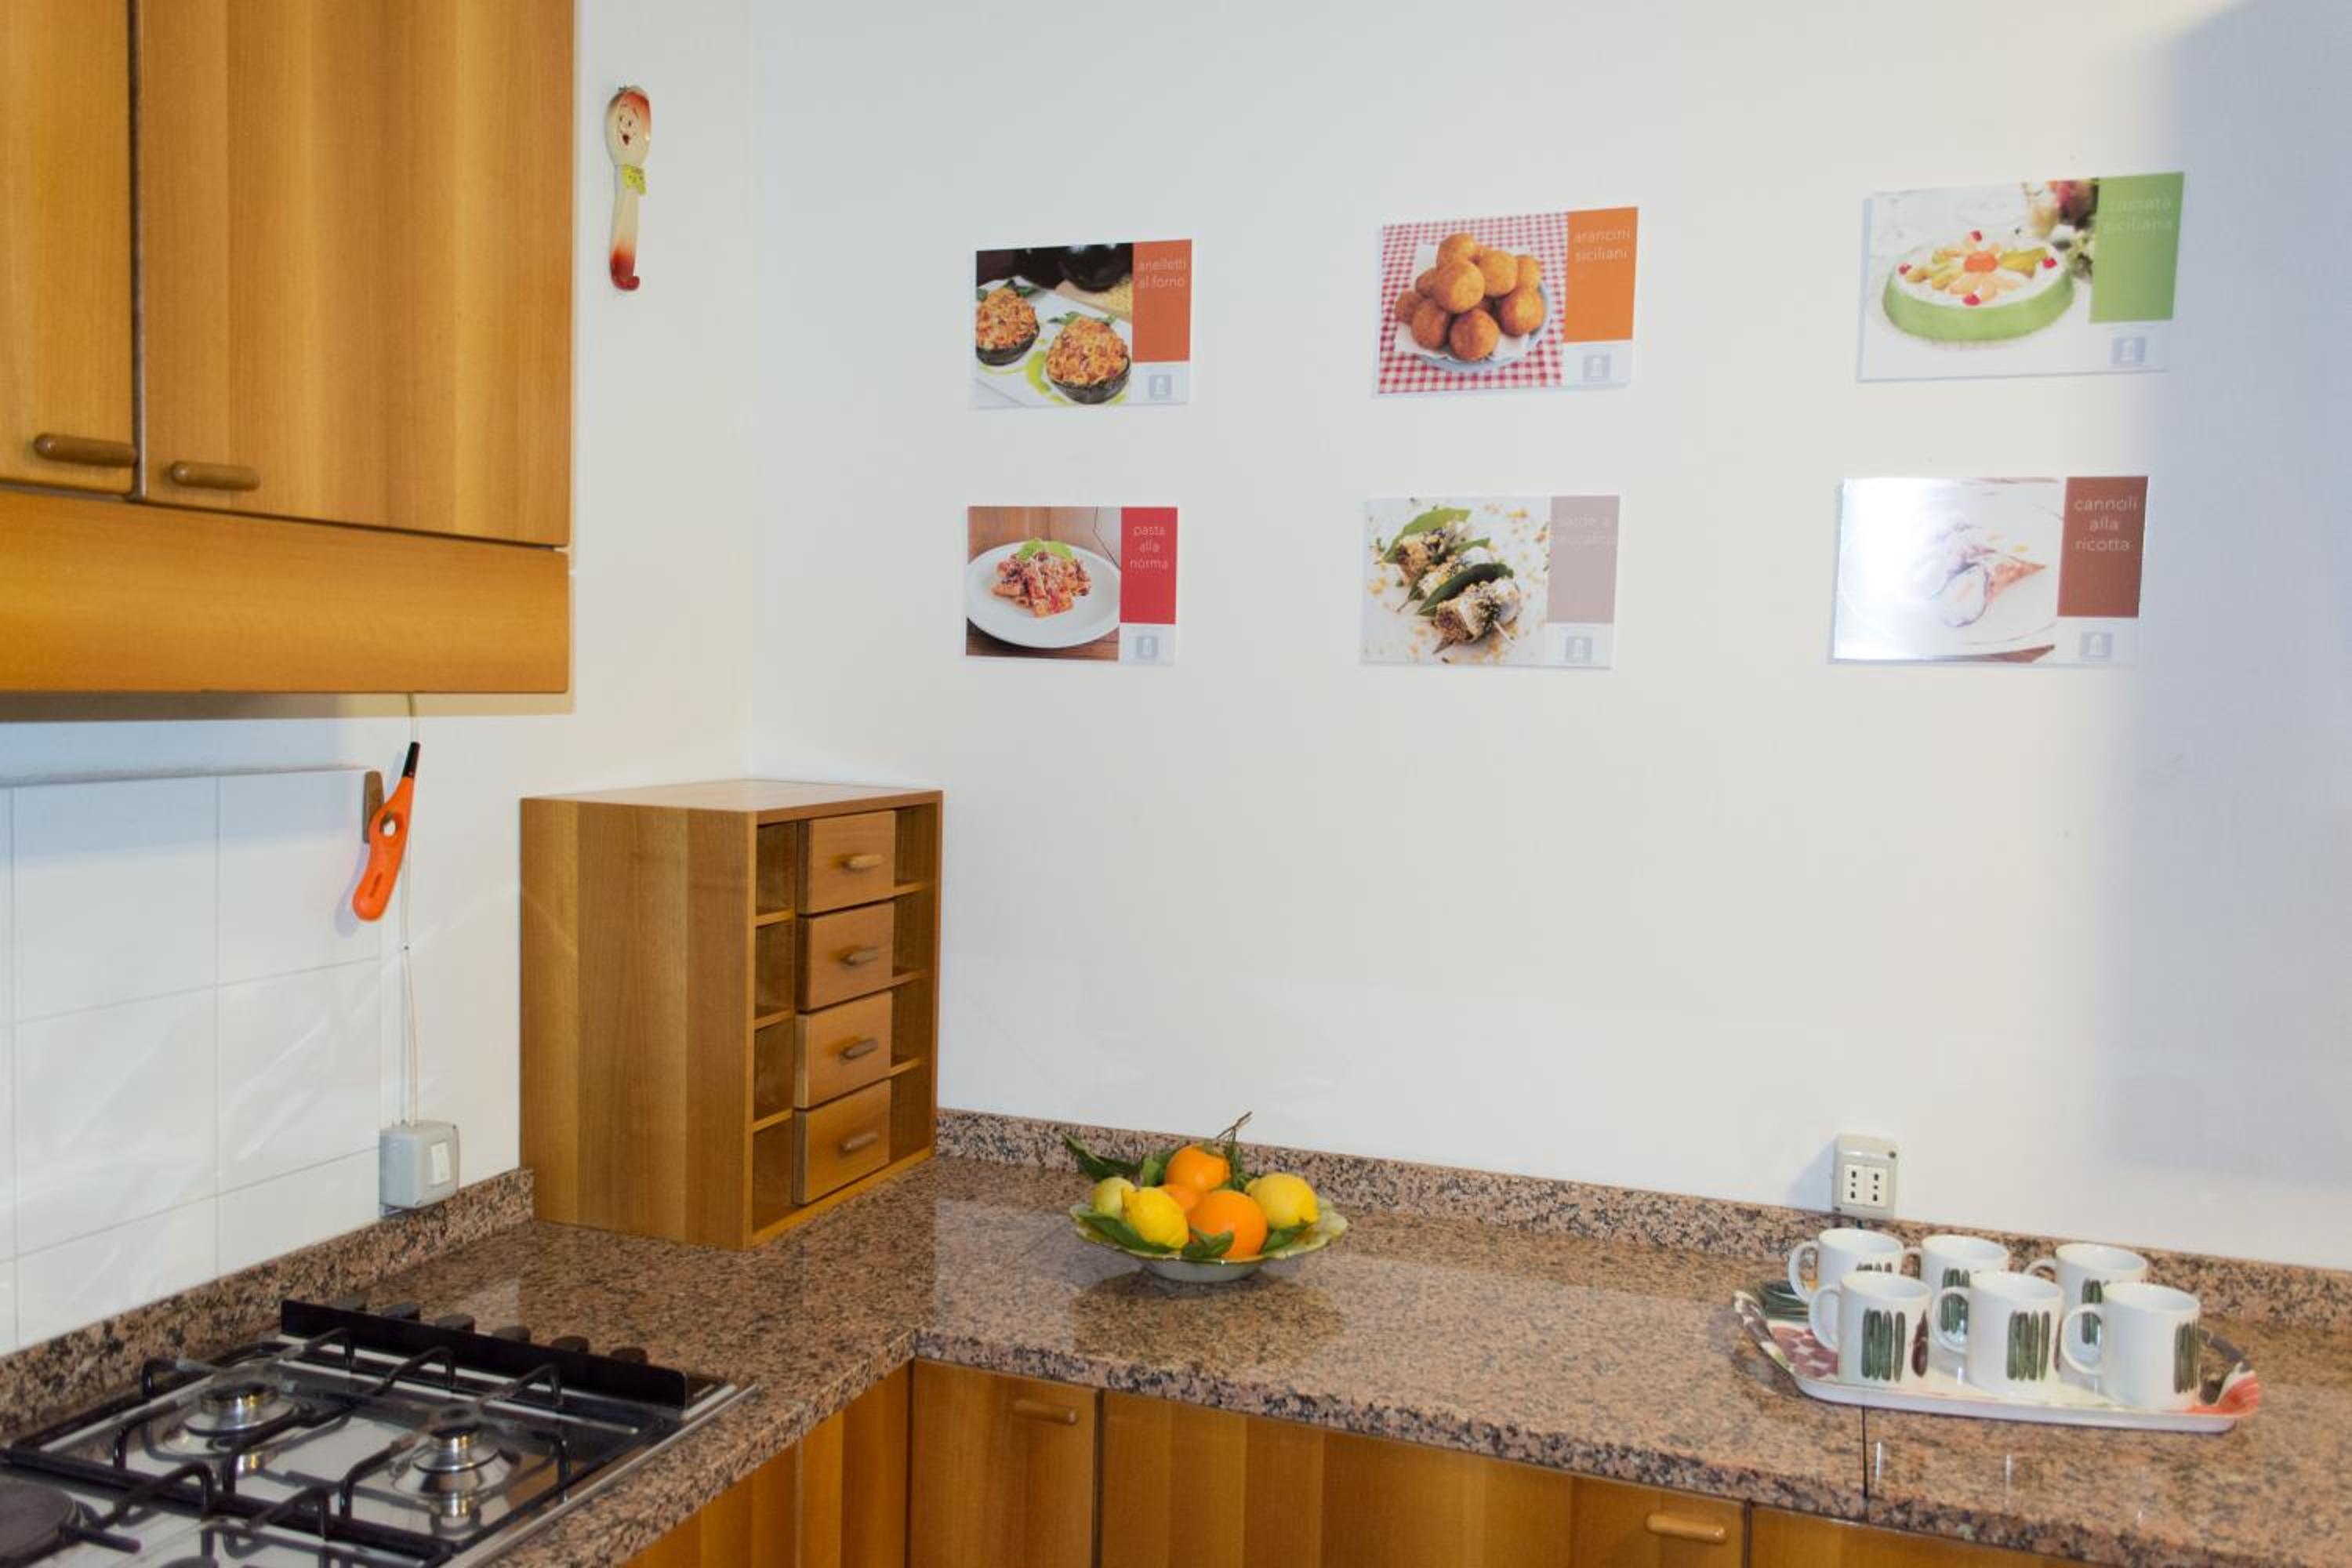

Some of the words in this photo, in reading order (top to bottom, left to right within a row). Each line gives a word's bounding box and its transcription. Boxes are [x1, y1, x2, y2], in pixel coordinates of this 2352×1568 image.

[1573, 227, 1631, 244] arancini
[1574, 245, 1628, 263] siciliani
[1138, 276, 1149, 289] al
[1152, 275, 1185, 289] forno
[2074, 495, 2138, 512] cannoli
[1133, 526, 1167, 537] pasta
[2089, 516, 2119, 532] alla
[1139, 539, 1160, 553] alla
[2074, 536, 2131, 552] ricotta
[1130, 558, 1168, 571] norma
